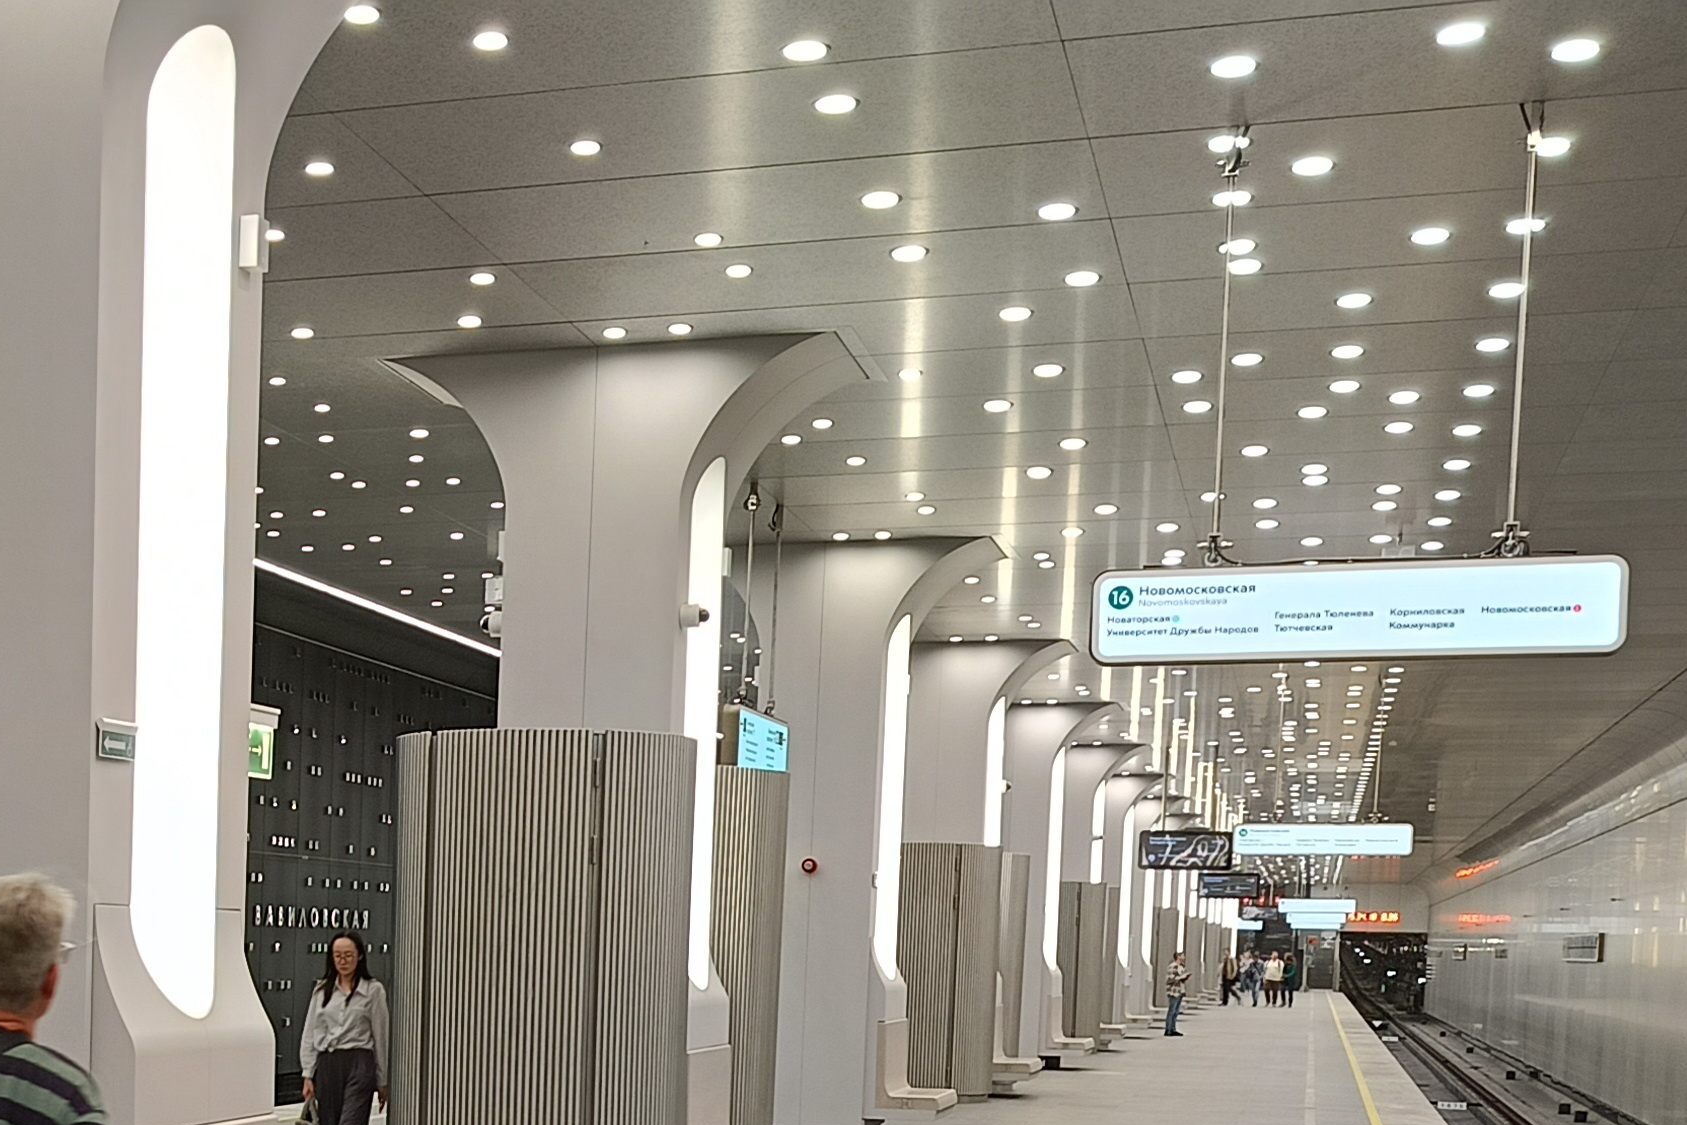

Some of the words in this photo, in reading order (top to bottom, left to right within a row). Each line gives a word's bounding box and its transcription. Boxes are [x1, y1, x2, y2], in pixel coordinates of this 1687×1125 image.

[1112, 590, 1130, 606] 16
[1139, 584, 1257, 597] Новомосковская
[1389, 607, 1465, 617] Корниловская
[1481, 604, 1572, 614] Новомосковская
[1274, 611, 1321, 620] Генерала
[1324, 609, 1374, 618] Тюленева
[1107, 616, 1171, 624] Новаторская
[1389, 620, 1455, 630] Коммунарка
[1107, 628, 1168, 637] Университет
[1170, 626, 1212, 637] Дружбы
[1214, 625, 1259, 634] Народов
[1274, 623, 1333, 632] Тютчевская
[255, 904, 369, 929] ВАВИЛОВСКАЯ
